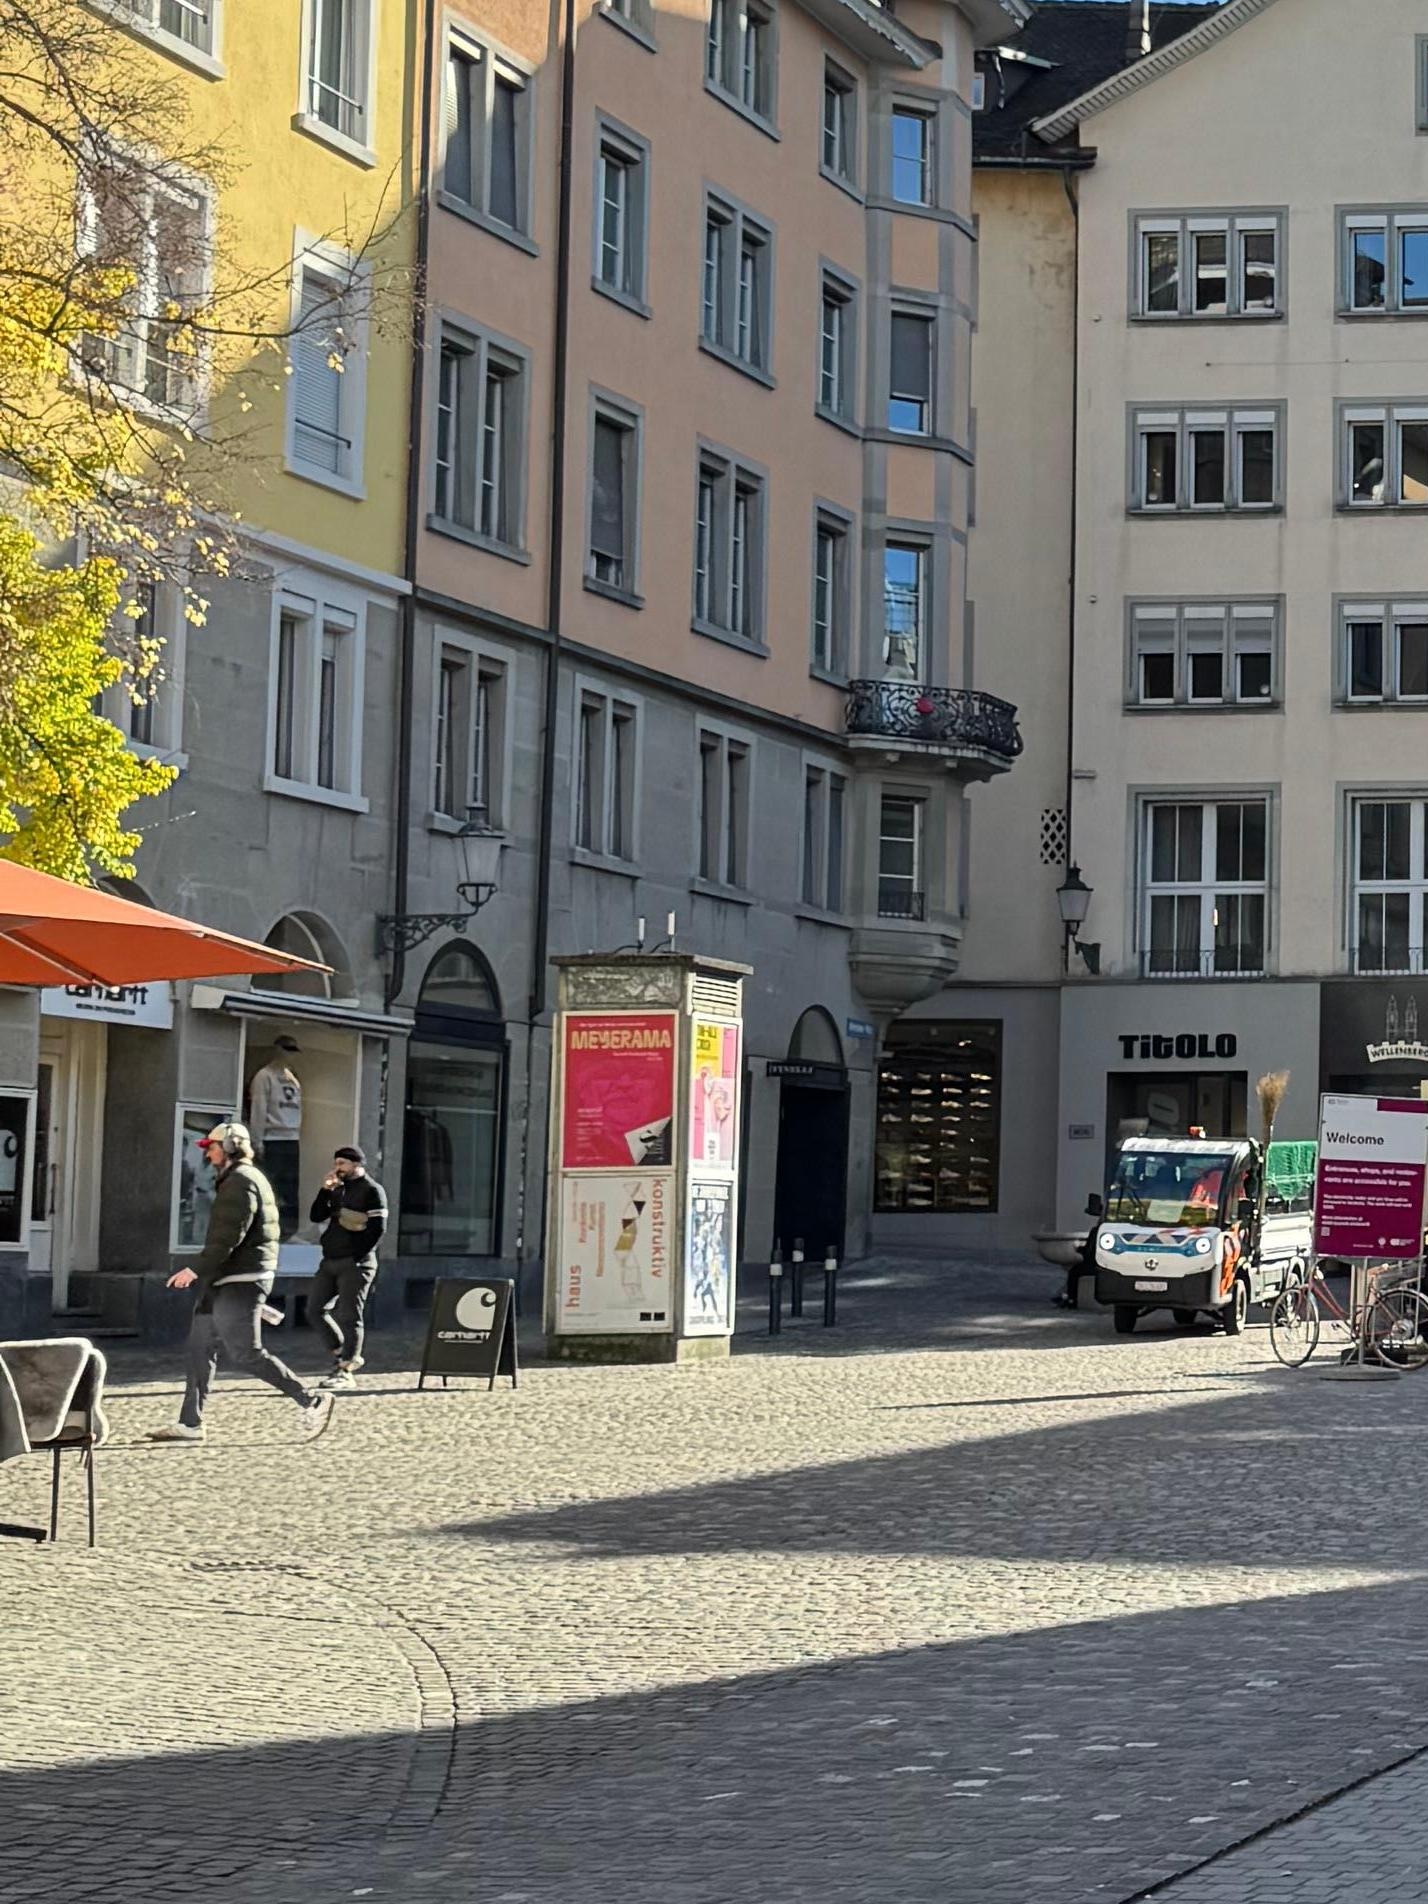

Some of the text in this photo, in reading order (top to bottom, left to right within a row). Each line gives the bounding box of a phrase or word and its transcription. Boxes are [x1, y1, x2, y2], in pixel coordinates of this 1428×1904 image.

[570, 1029, 671, 1050] MEYERAMA
[1326, 1131, 1385, 1146] Welcome
[651, 1178, 668, 1279] konstruktiv
[565, 1264, 582, 1308] haus
